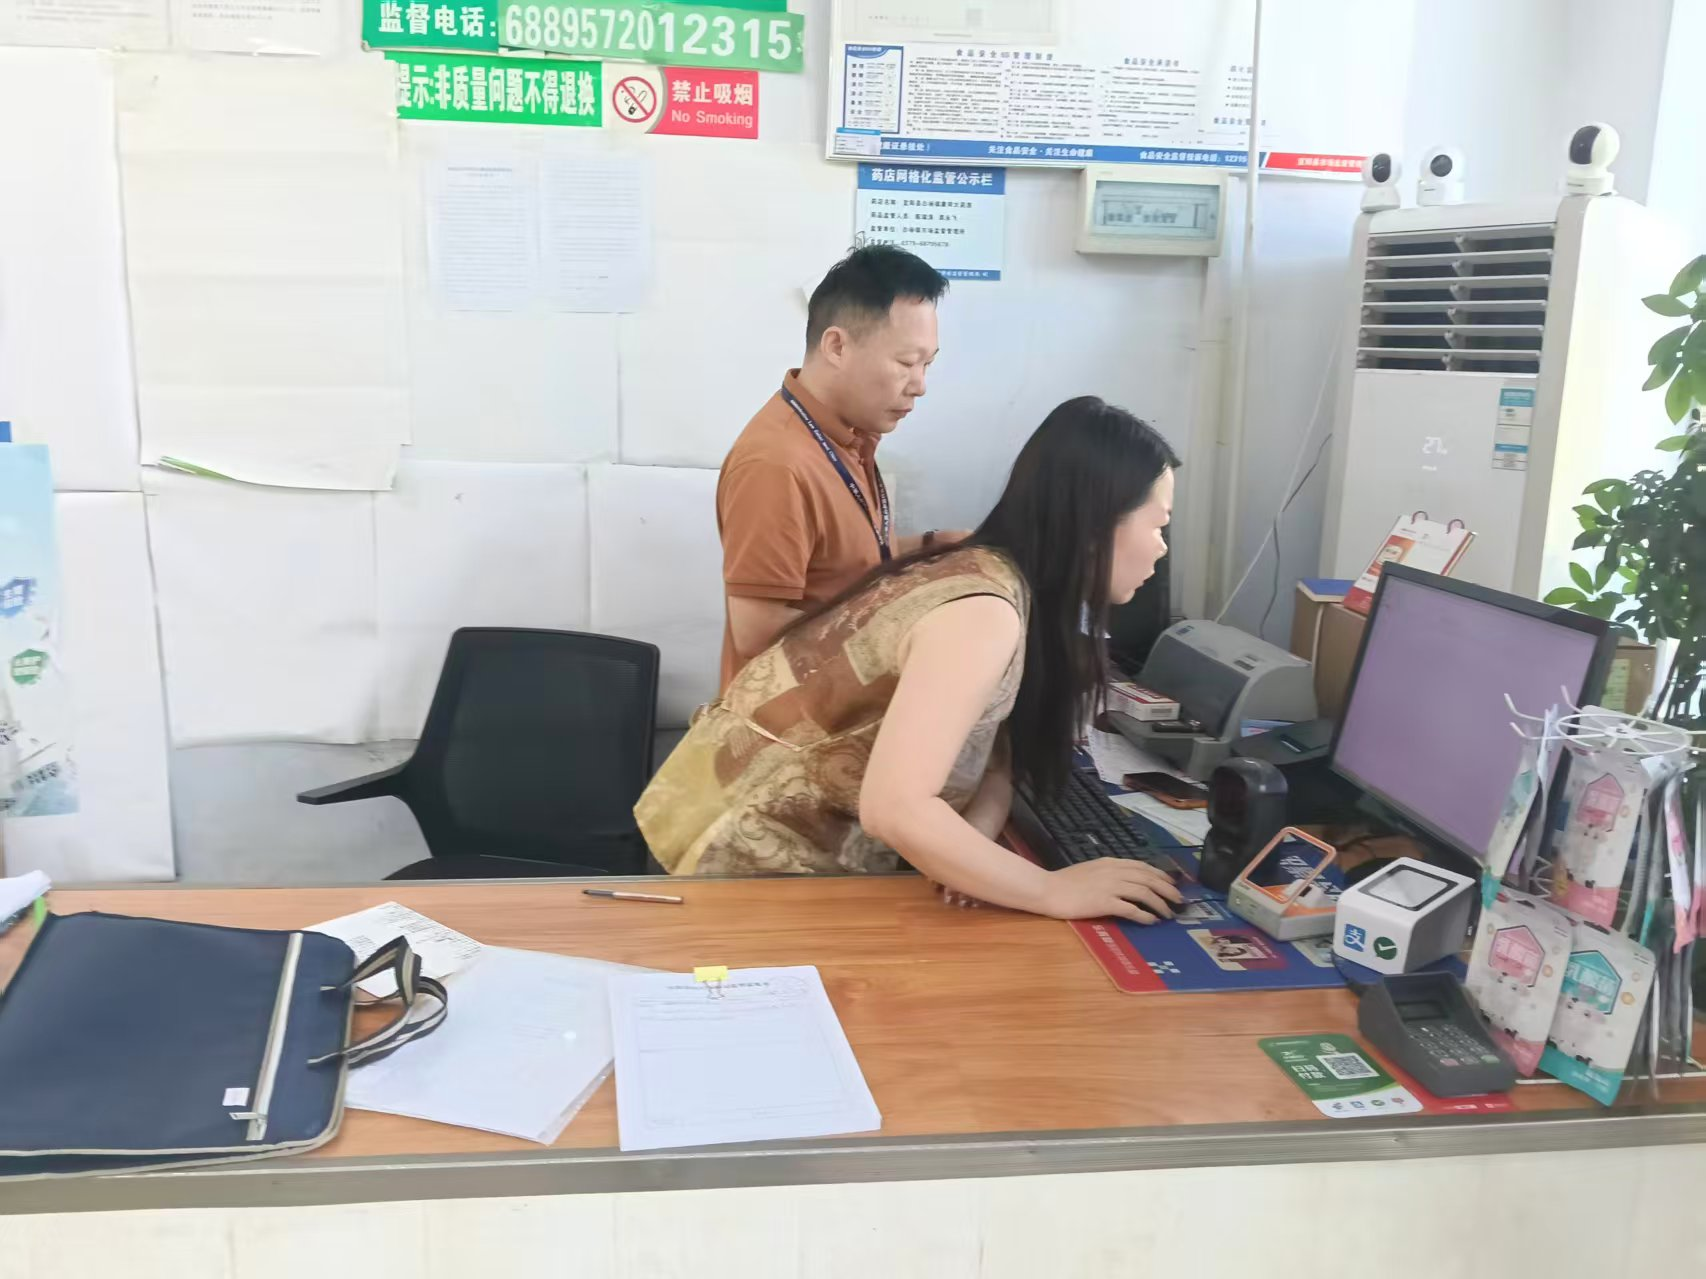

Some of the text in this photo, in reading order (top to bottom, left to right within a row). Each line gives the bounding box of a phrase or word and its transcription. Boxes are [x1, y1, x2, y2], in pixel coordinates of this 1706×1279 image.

[672, 80, 753, 106] 禁止吸烟
[671, 110, 753, 128] No Smoking
[871, 168, 993, 186] 药店网格化监管公示栏
